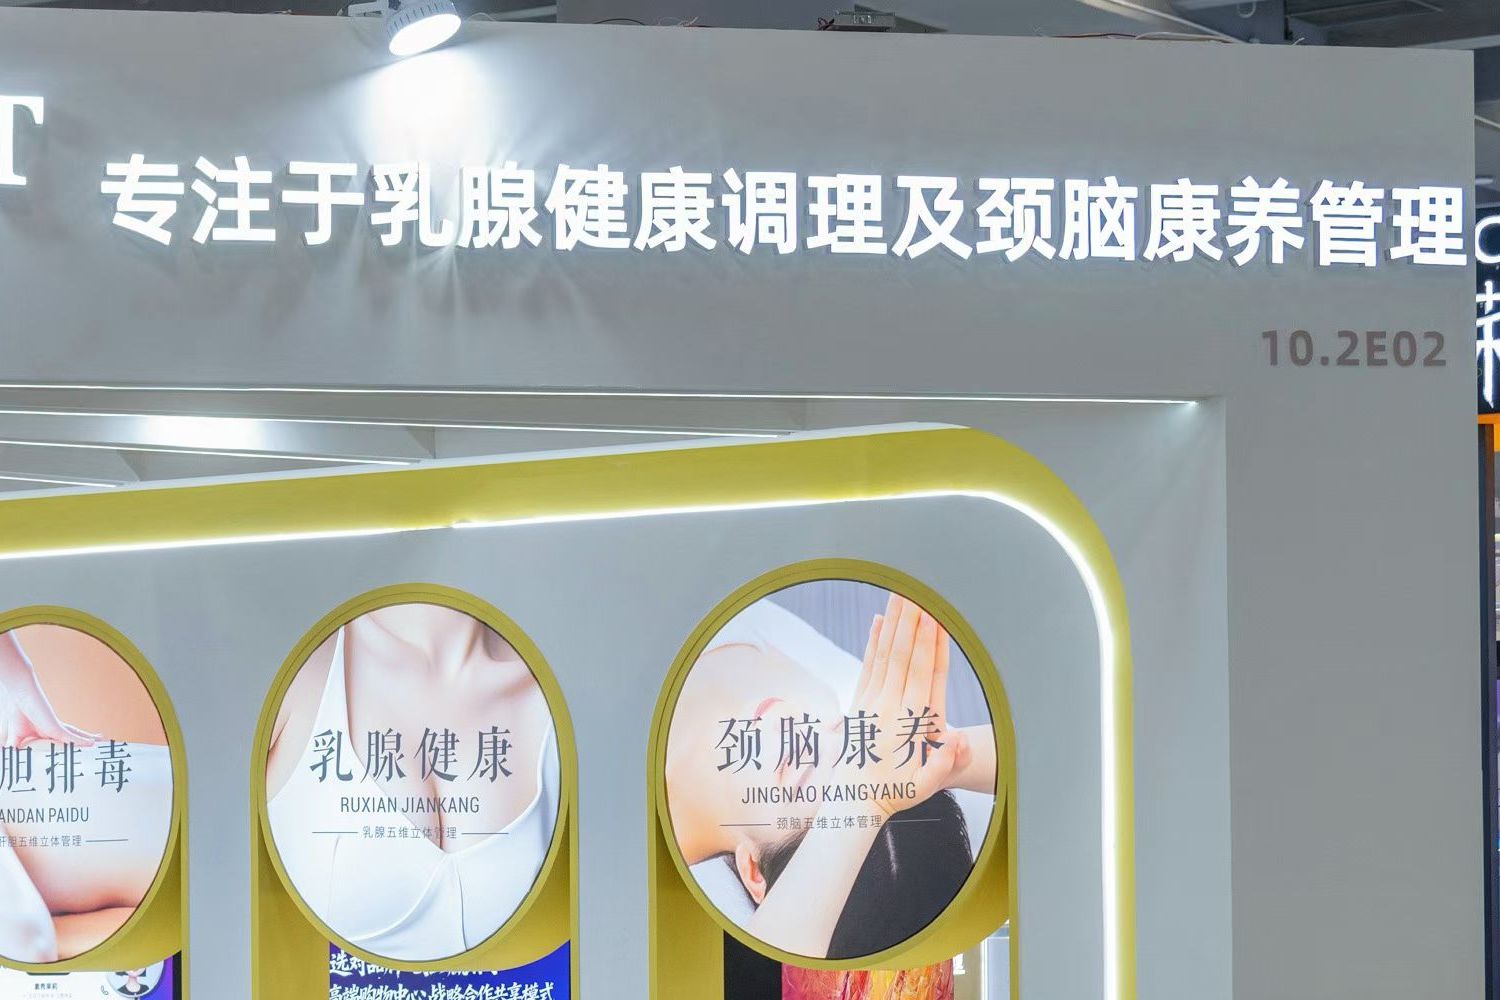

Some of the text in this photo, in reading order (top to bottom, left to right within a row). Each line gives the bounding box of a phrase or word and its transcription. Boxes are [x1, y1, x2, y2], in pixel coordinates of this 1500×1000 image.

[100, 153, 1468, 268] 专注于乳腺健康调理及颈脑康养管理
[1261, 329, 1447, 367] 10.2E02
[714, 706, 945, 775] 颈脑康养
[309, 725, 514, 784] 乳腺健康
[741, 781, 917, 804] JINGNAO KANGYANG
[48, 806, 90, 823] PAIDU
[340, 796, 480, 814] RUXIAN JIANKANG
[362, 825, 458, 840] 乳腺五维立体管理
[776, 815, 883, 831] 颈脑五维立体管理
